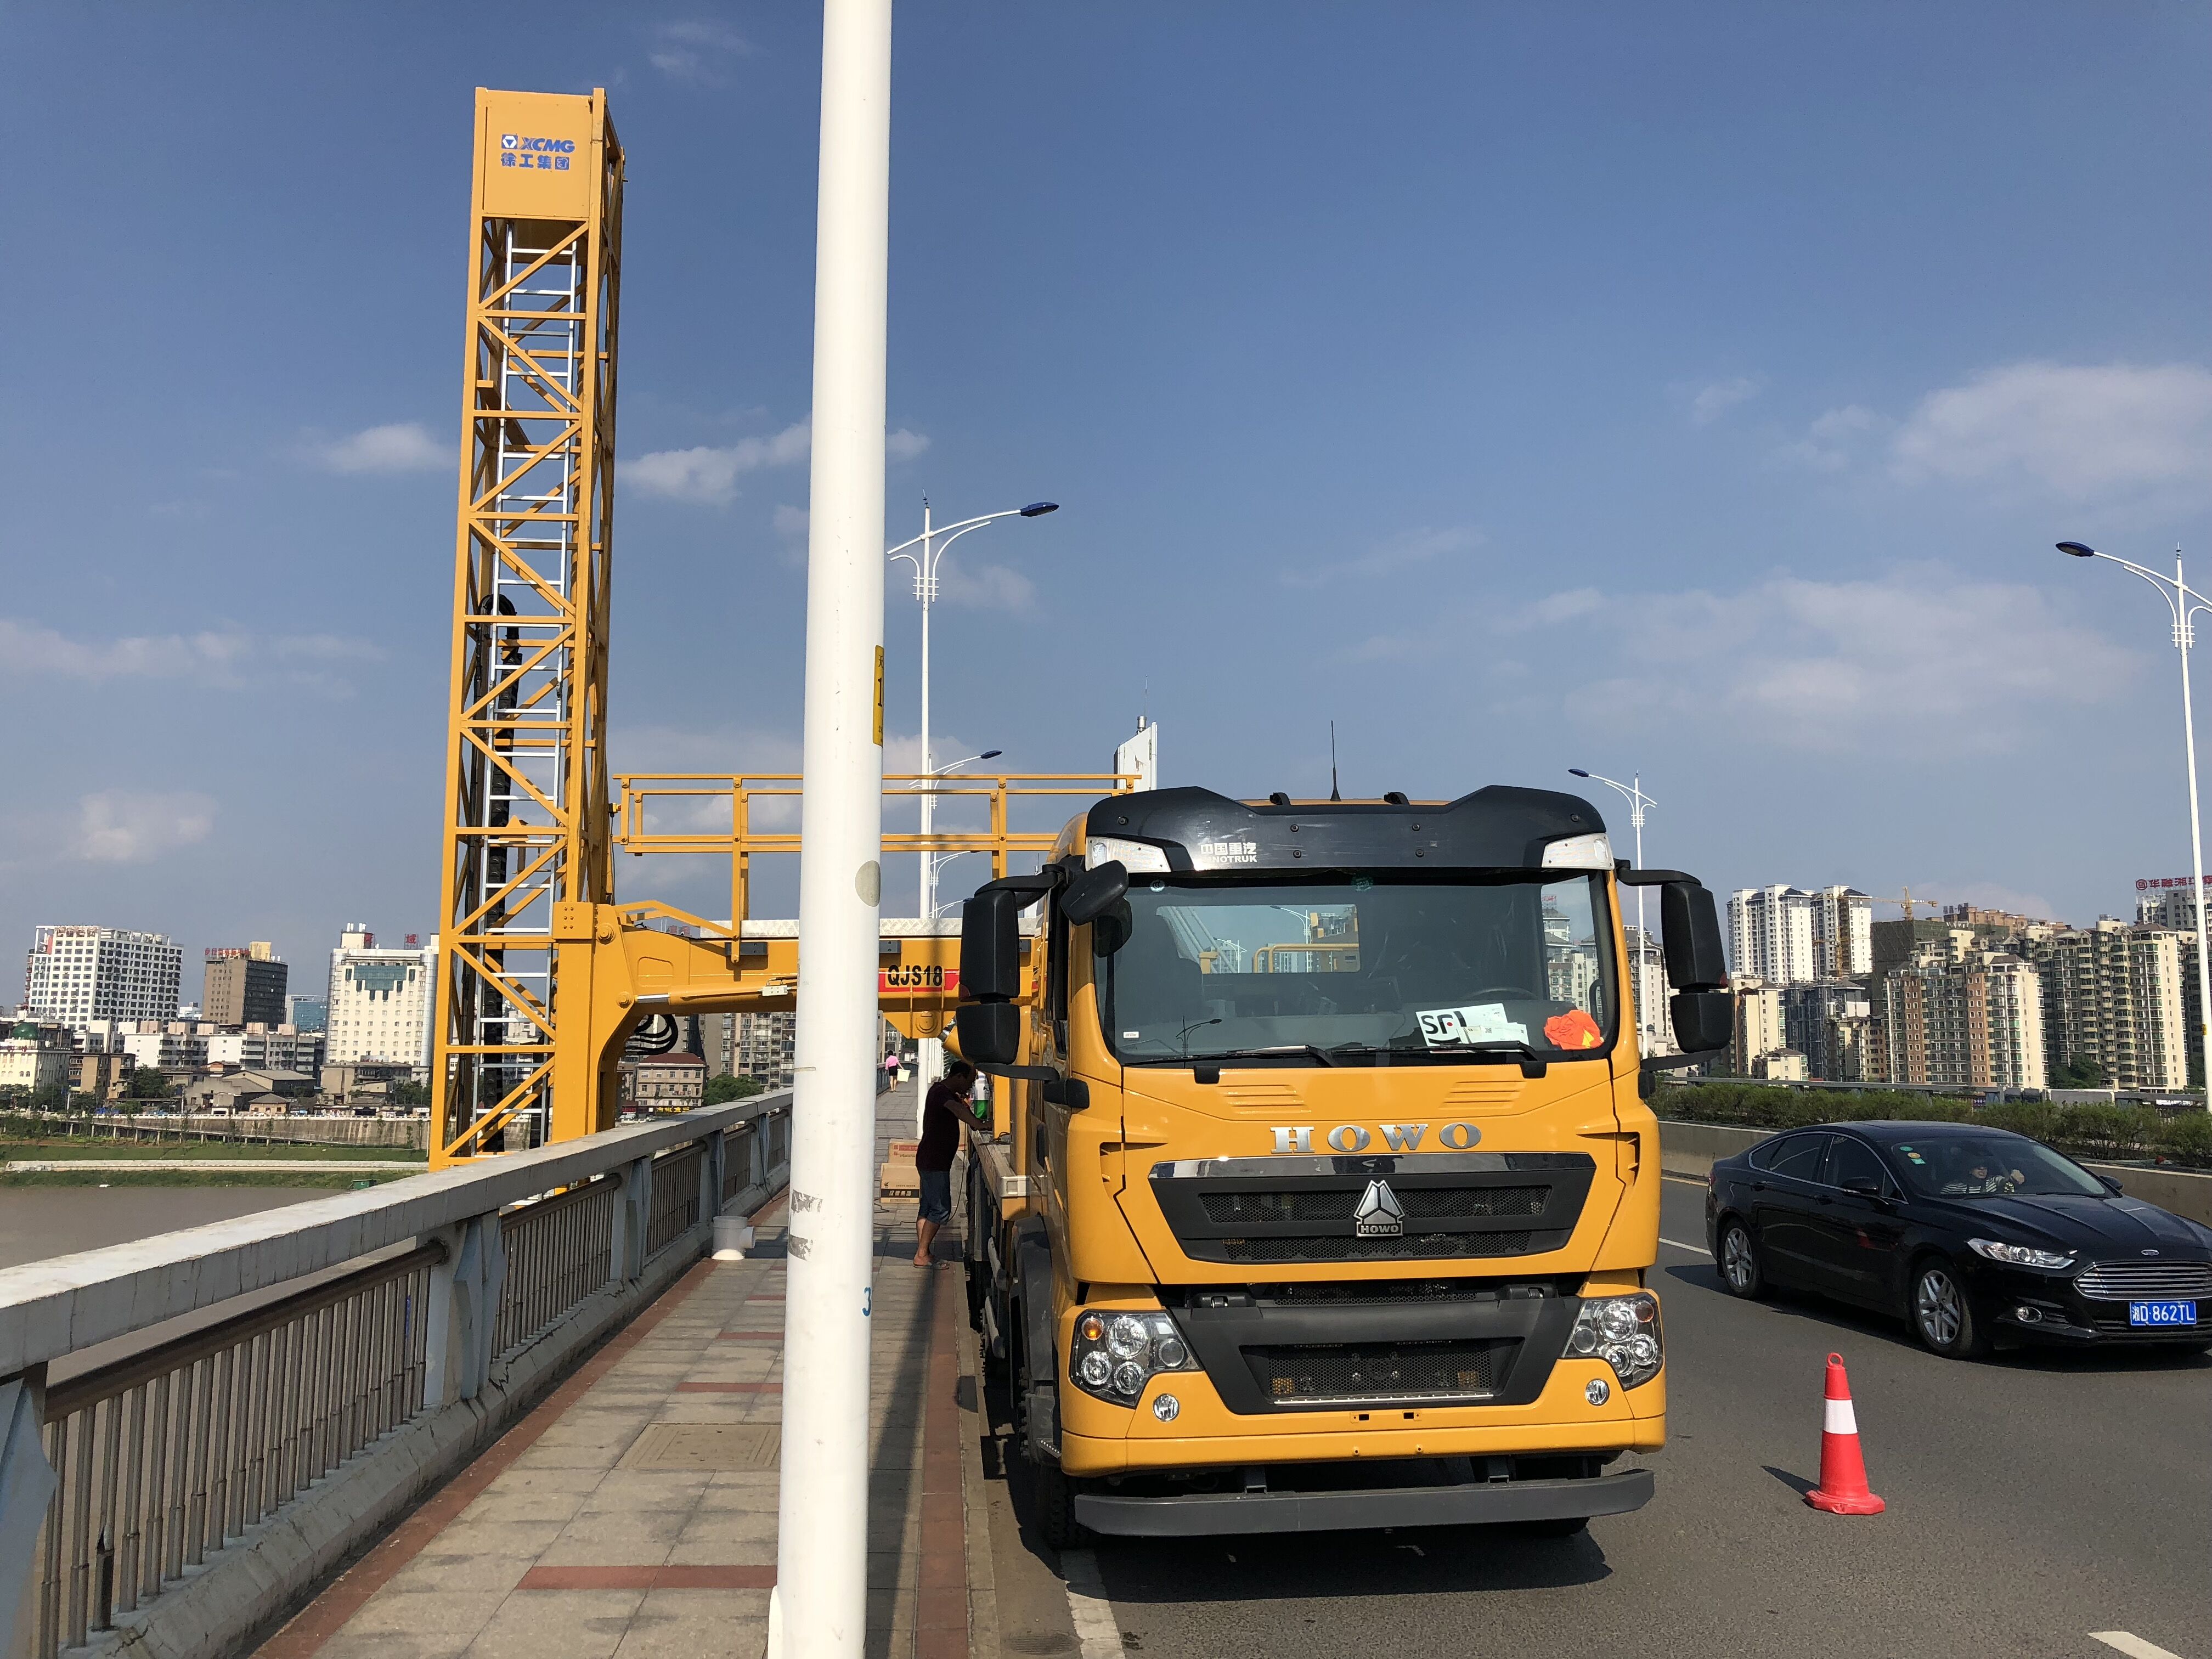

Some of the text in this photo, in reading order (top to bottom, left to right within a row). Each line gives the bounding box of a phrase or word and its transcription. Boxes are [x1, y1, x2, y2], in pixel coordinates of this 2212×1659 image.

[521, 137, 575, 153] XCMG
[501, 152, 569, 170] 徐工集团
[1201, 842, 1256, 855] 中国重汽
[888, 964, 943, 986] QJS18
[1270, 1122, 1482, 1154] HOWO
[1361, 1225, 1399, 1233] HOWO
